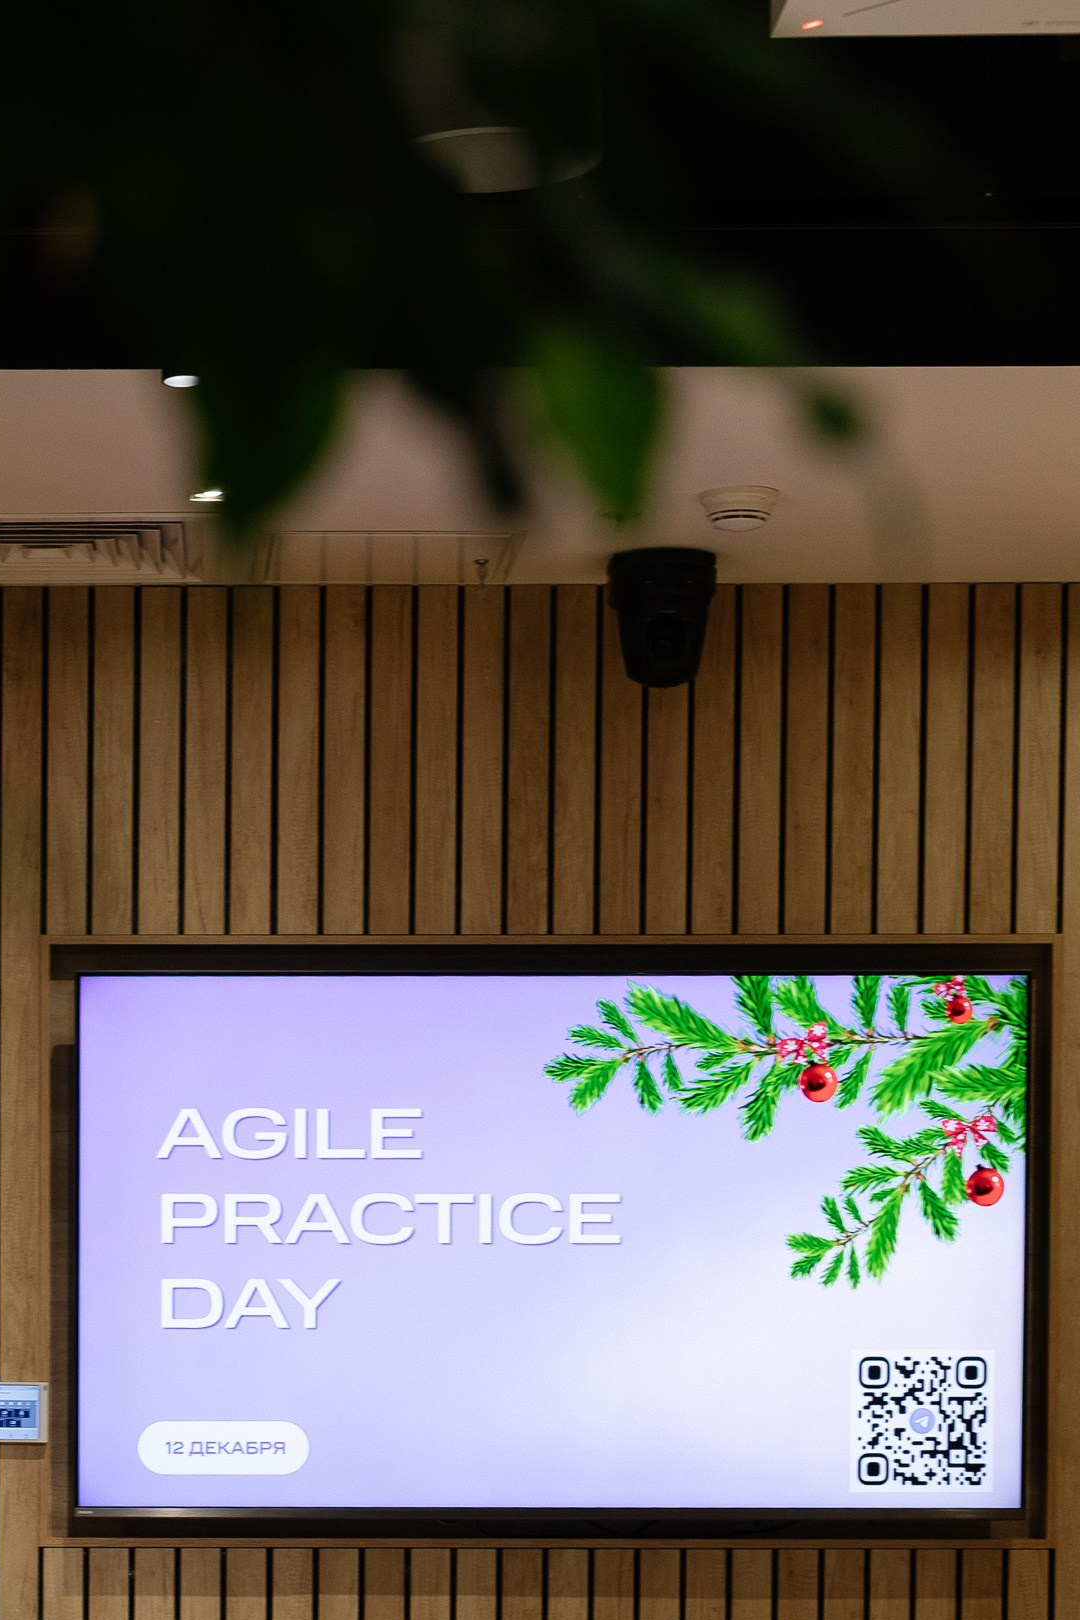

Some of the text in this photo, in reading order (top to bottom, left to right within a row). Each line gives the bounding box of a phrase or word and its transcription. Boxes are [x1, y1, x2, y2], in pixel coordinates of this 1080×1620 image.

[155, 1107, 423, 1160] AGILE
[159, 1192, 622, 1246] PRACTICE
[159, 1278, 342, 1330] DAY
[164, 1441, 286, 1457] 12 ДЕКАБРЯ
